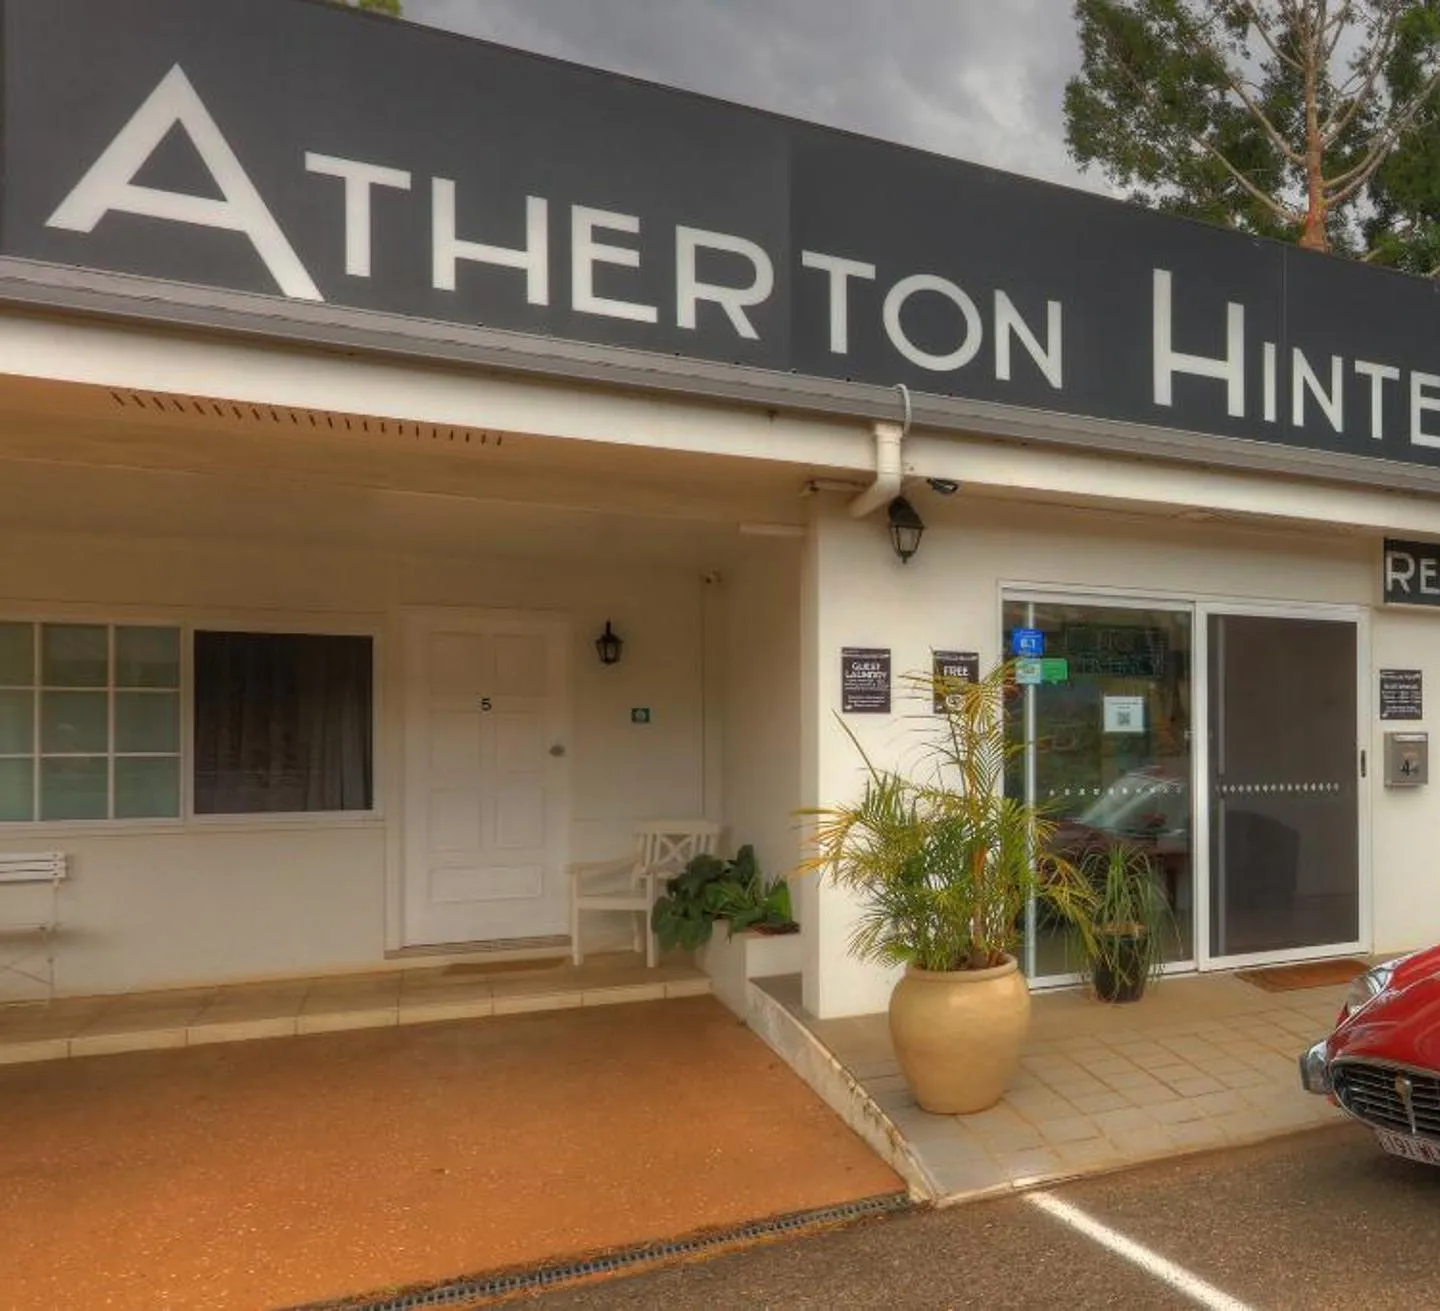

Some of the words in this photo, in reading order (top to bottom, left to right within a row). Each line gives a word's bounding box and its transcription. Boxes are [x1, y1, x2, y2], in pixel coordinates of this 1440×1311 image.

[44, 62, 1063, 390] ATHERTON
[943, 665, 969, 677] FREE
[480, 697, 492, 712] 5
